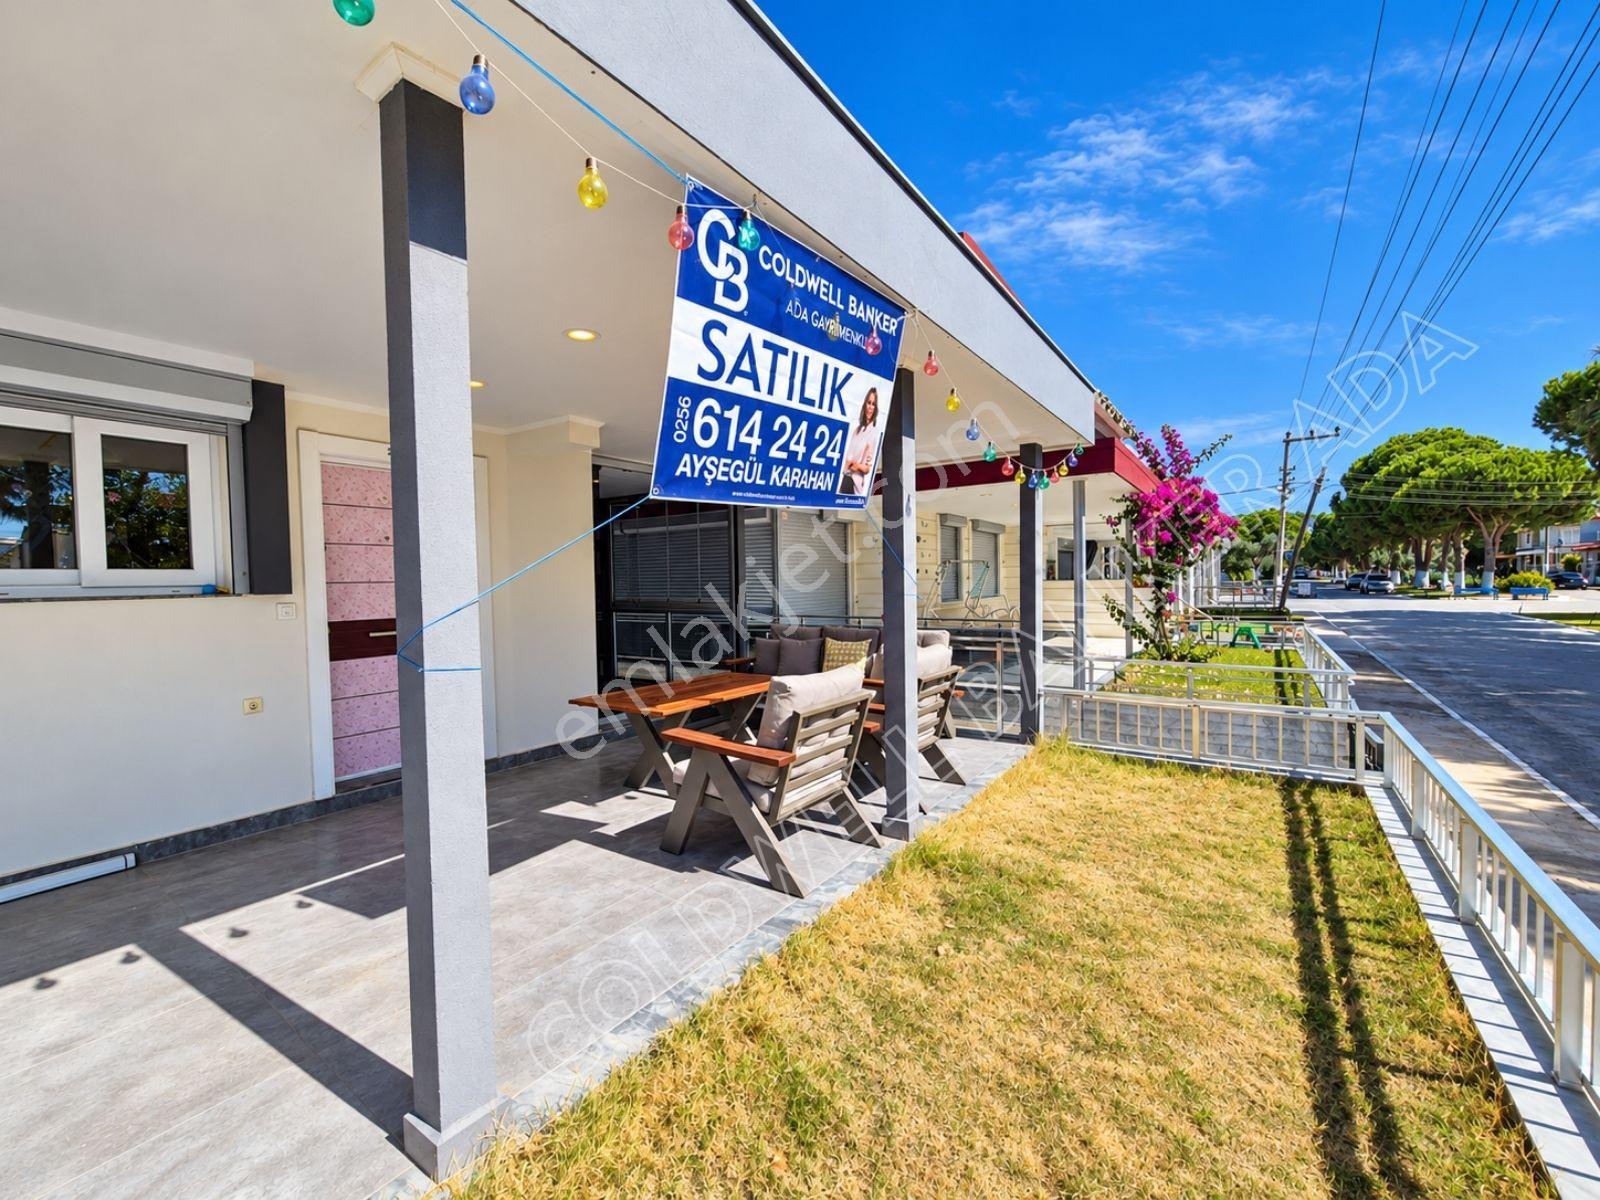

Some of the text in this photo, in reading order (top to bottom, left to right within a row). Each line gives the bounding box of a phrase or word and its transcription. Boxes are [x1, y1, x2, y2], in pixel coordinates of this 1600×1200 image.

[697, 209, 748, 312] CB
[758, 245, 898, 337] COLDWELL BANKER
[785, 299, 809, 323] ADA
[697, 319, 854, 417] SATILIK
[673, 396, 692, 443] 0256
[693, 397, 843, 467] 614 24 24
[675, 452, 835, 491] AYŞEGÜL KARAHAN
